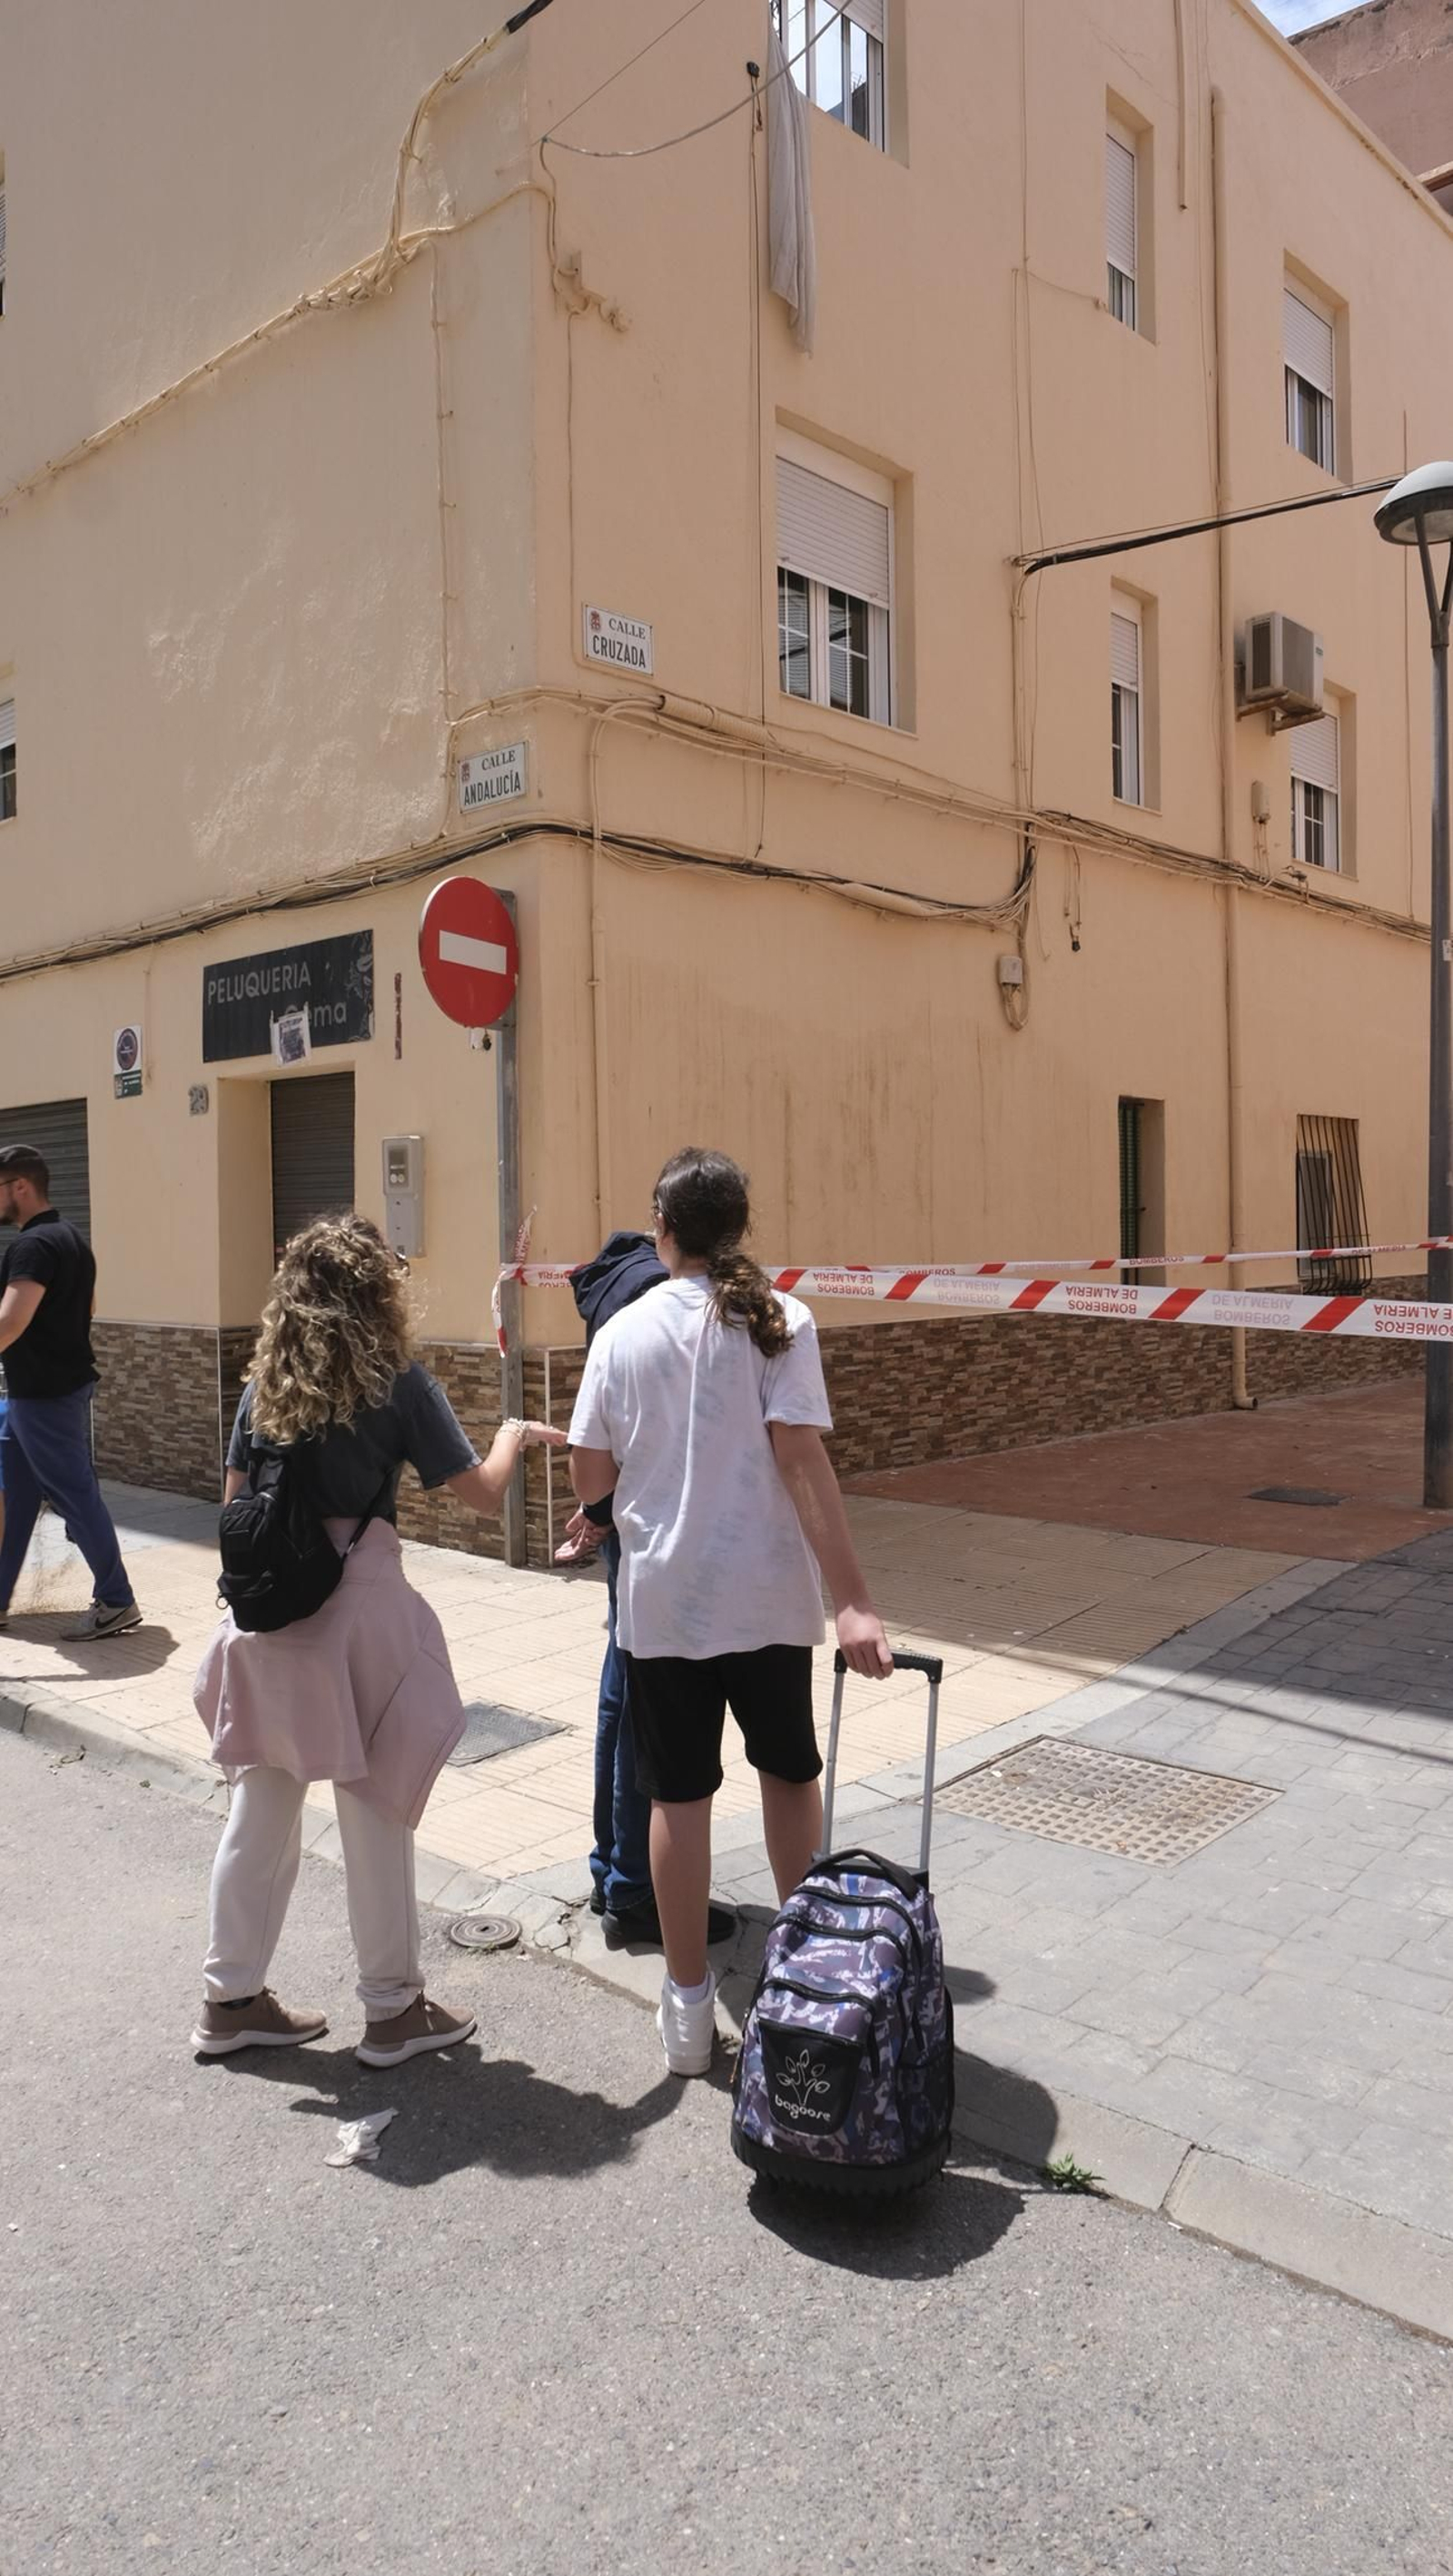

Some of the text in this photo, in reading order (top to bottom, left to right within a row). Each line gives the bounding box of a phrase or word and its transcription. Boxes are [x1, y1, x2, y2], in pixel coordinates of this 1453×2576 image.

[608, 618, 646, 639] CALLE
[592, 635, 646, 668] CRUZADA
[481, 750, 516, 771] CALLE
[464, 769, 521, 805] ANDALUCÍA
[208, 961, 311, 1004] PELUQUERIA
[814, 1272, 873, 1284] DE ALMERIA
[817, 1284, 875, 1296] BOMBEROS
[1065, 1286, 1138, 1299] DE ALMERIA
[1068, 1299, 1137, 1314] BOMBEROS
[1374, 1304, 1452, 1319] E ALMERIA
[775, 2094, 831, 2122] bagoose
